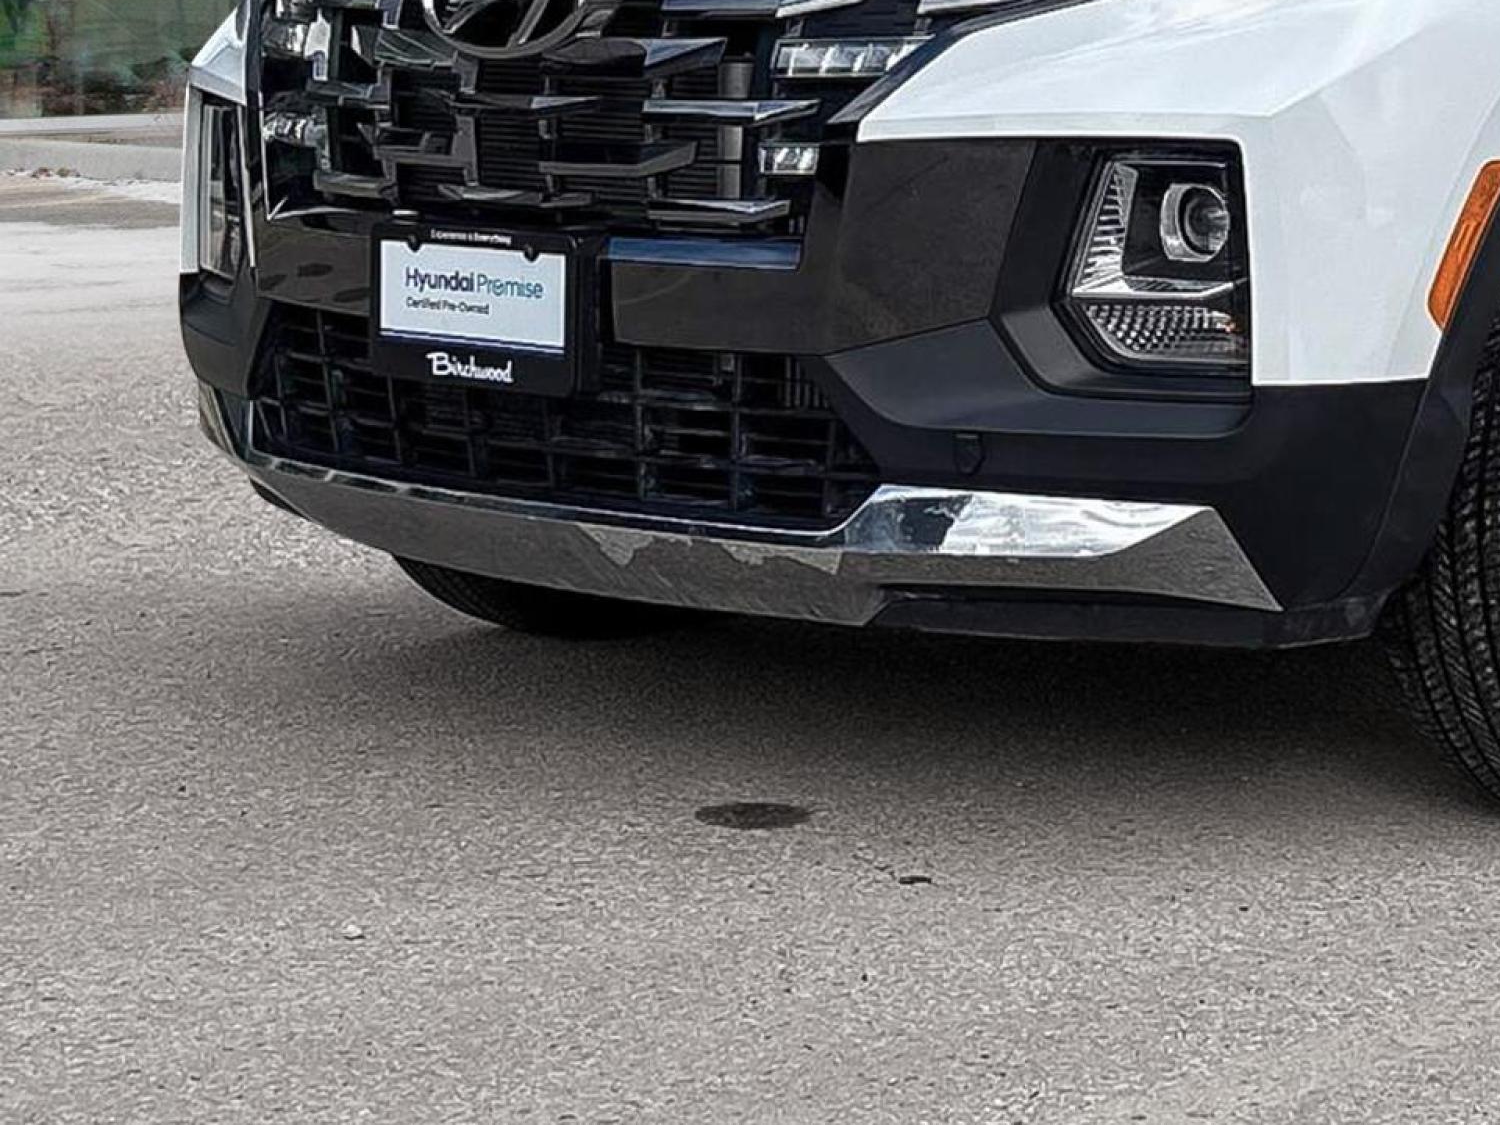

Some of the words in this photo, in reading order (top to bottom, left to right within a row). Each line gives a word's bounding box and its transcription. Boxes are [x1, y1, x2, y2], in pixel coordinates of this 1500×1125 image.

[405, 266, 474, 293] Hyundai
[406, 296, 441, 310] Certified
[425, 351, 514, 383] Birchwood
